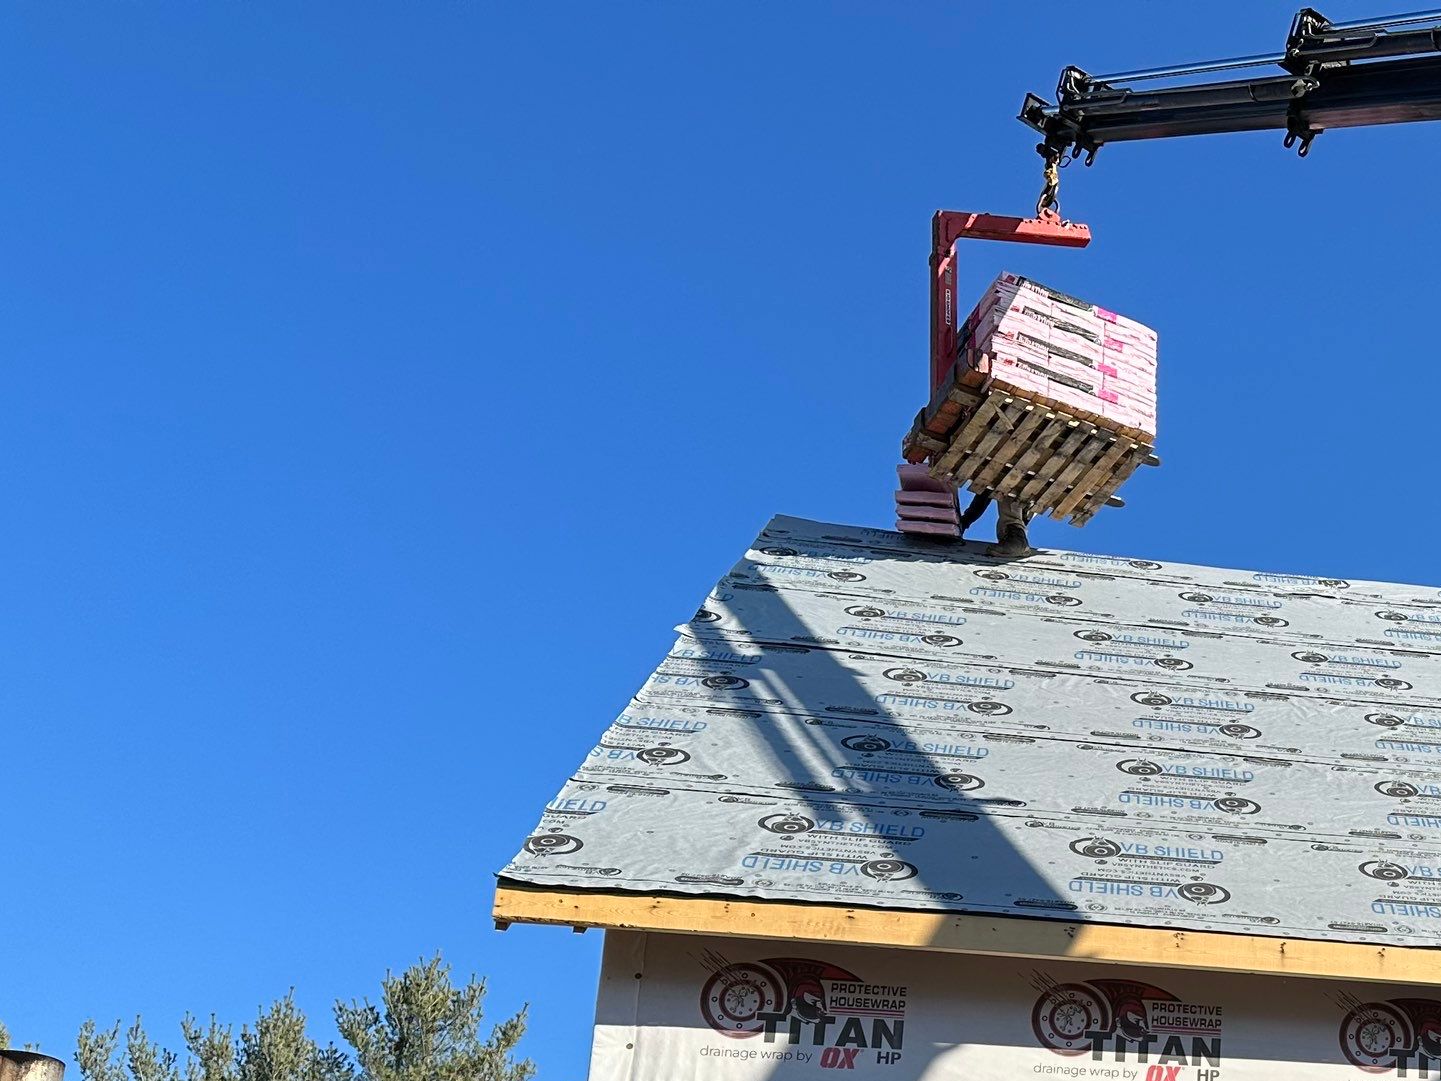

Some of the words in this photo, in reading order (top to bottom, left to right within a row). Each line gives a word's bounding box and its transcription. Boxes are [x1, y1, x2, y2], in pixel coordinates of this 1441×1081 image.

[927, 672, 949, 683] VB
[955, 675, 1015, 689] SHIELD
[1162, 763, 1187, 775] VB
[1192, 767, 1254, 781] SHIELD
[816, 819, 844, 831] VB
[850, 822, 925, 837] SHIELD
[1121, 842, 1148, 854] VB
[1154, 846, 1224, 860] SHIELD
[1407, 865, 1433, 877] VB
[1069, 880, 1143, 896] SHIELD
[1151, 886, 1179, 899] VB
[831, 983, 907, 997] PROTECTIVE
[830, 996, 906, 1011] HOUSEWRAP
[757, 1013, 904, 1049] TITAN
[700, 1046, 757, 1061] drainage
[759, 1049, 793, 1063] wrap
[796, 1049, 813, 1064] by
[820, 1047, 858, 1070] OX
[876, 1051, 902, 1065] HP
